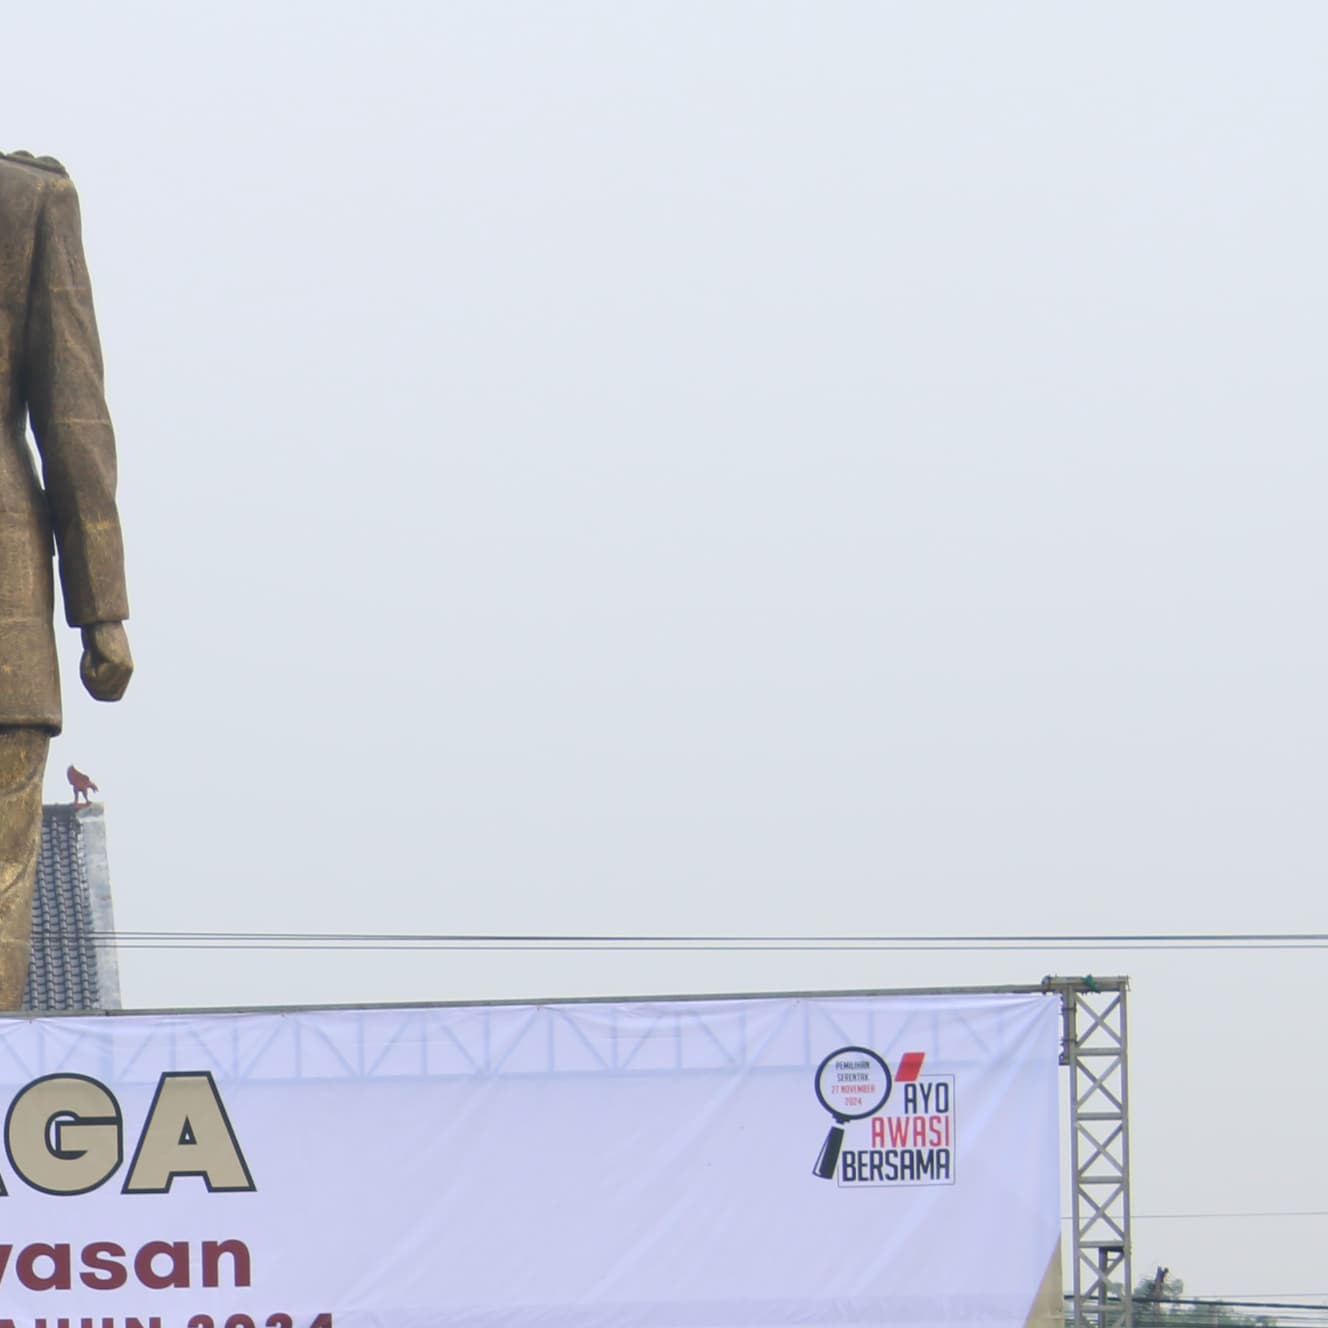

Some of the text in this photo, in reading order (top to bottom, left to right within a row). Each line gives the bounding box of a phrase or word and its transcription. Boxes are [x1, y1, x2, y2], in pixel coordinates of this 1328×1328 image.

[904, 1082, 949, 1114] AYO
[871, 1115, 950, 1148] AWASI
[842, 1148, 950, 1182] BERSAMA
